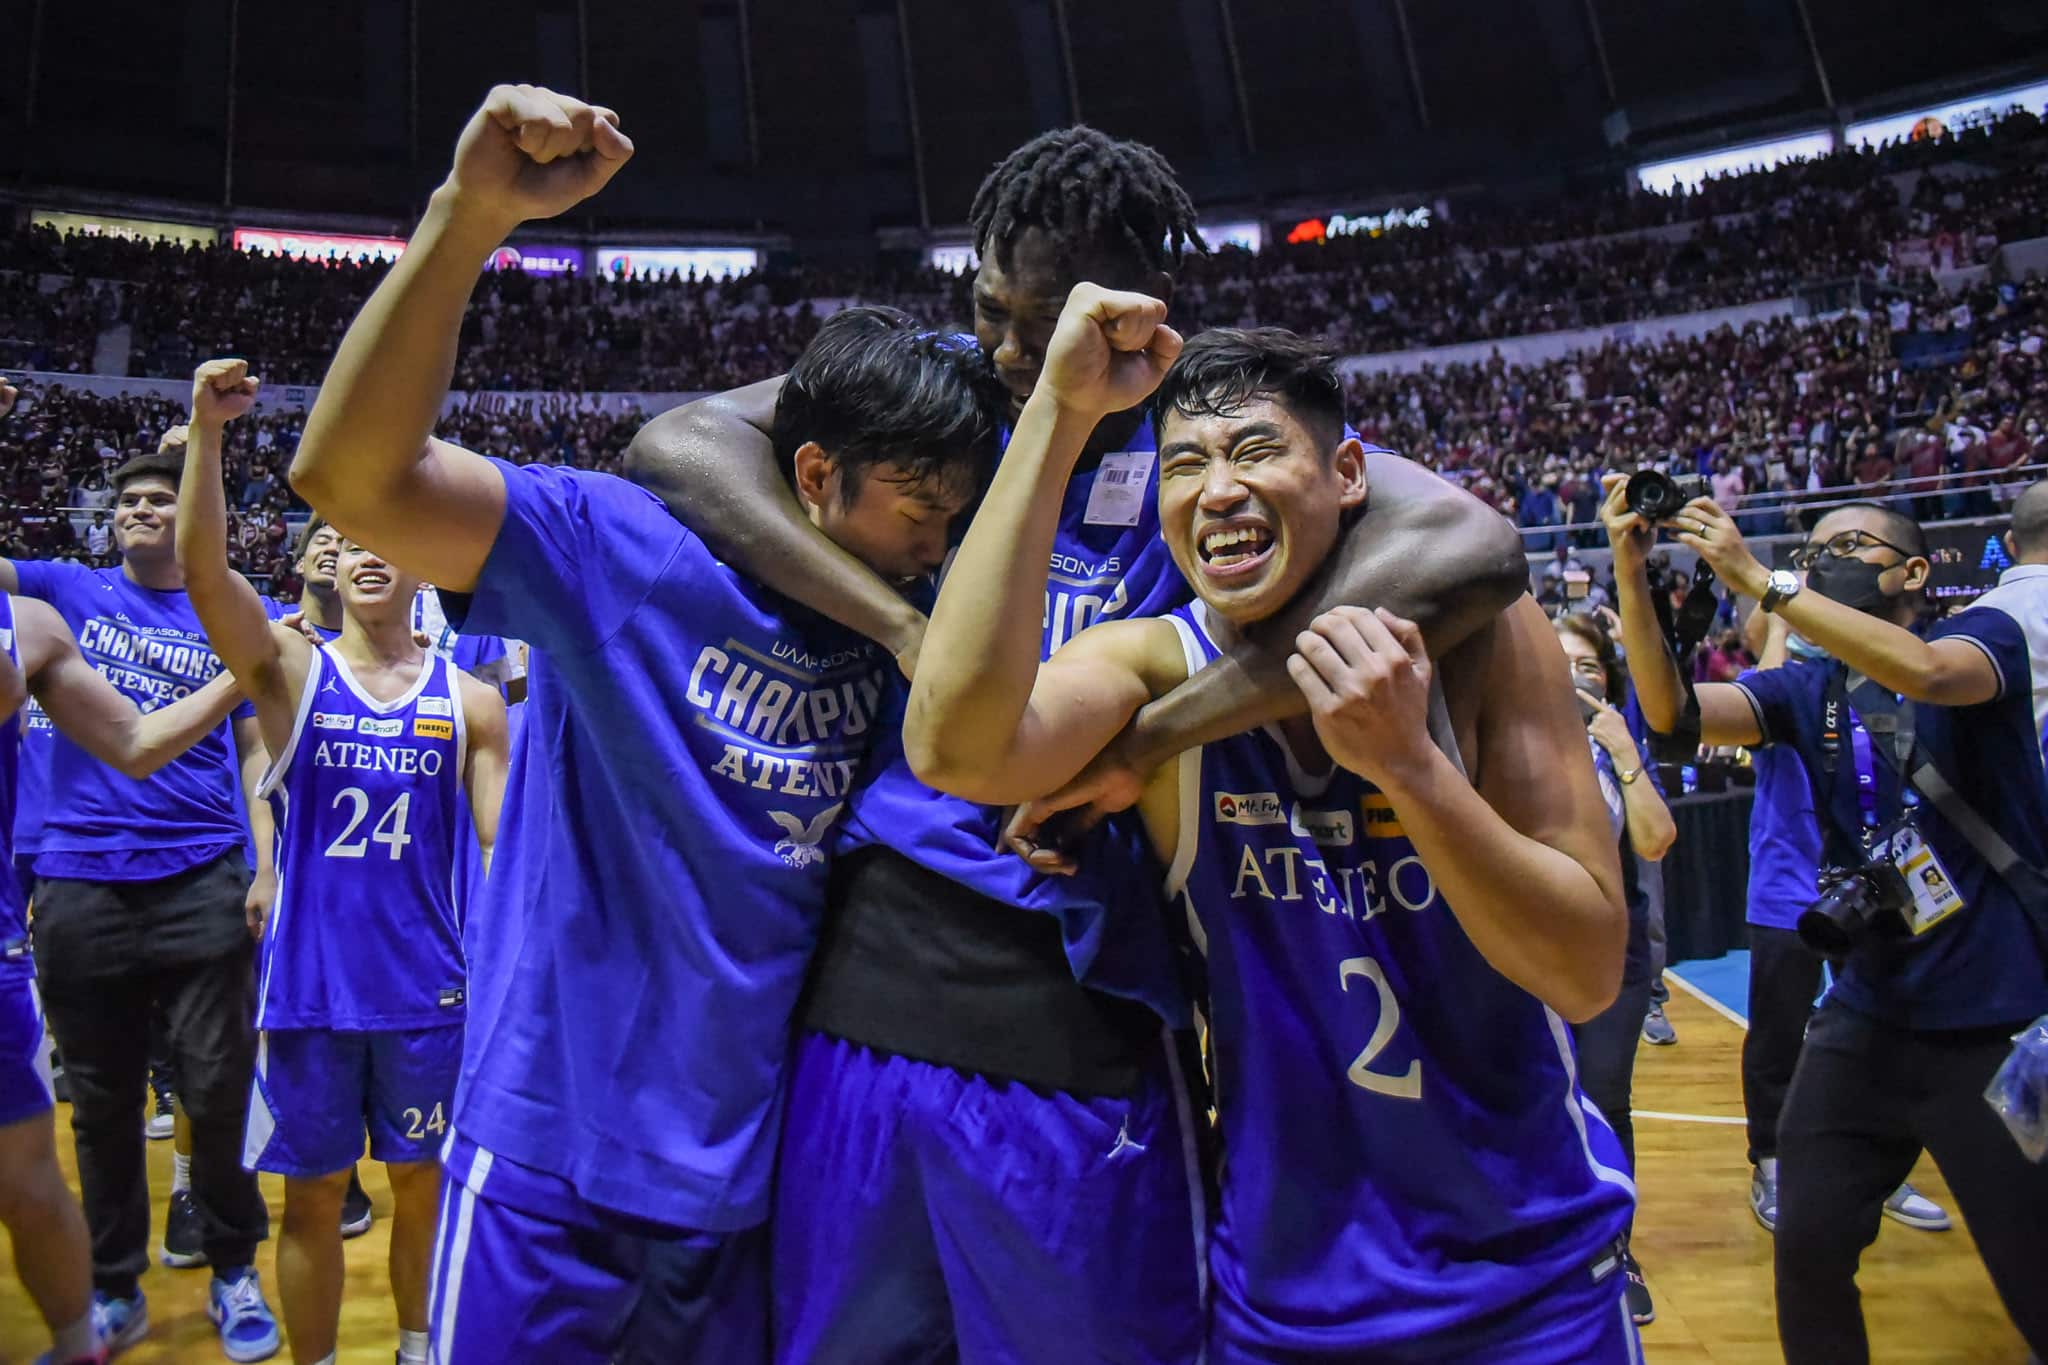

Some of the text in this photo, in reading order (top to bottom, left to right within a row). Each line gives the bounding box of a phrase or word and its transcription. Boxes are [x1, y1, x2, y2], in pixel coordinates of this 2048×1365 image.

[1050, 553, 1093, 577] SON
[80, 619, 221, 681] CHAMPIONS
[417, 723, 450, 734] FIREFLY
[315, 740, 443, 776] ATENEO
[324, 787, 412, 860] 24
[1339, 956, 1422, 1099] 2
[402, 1101, 446, 1139] 24
